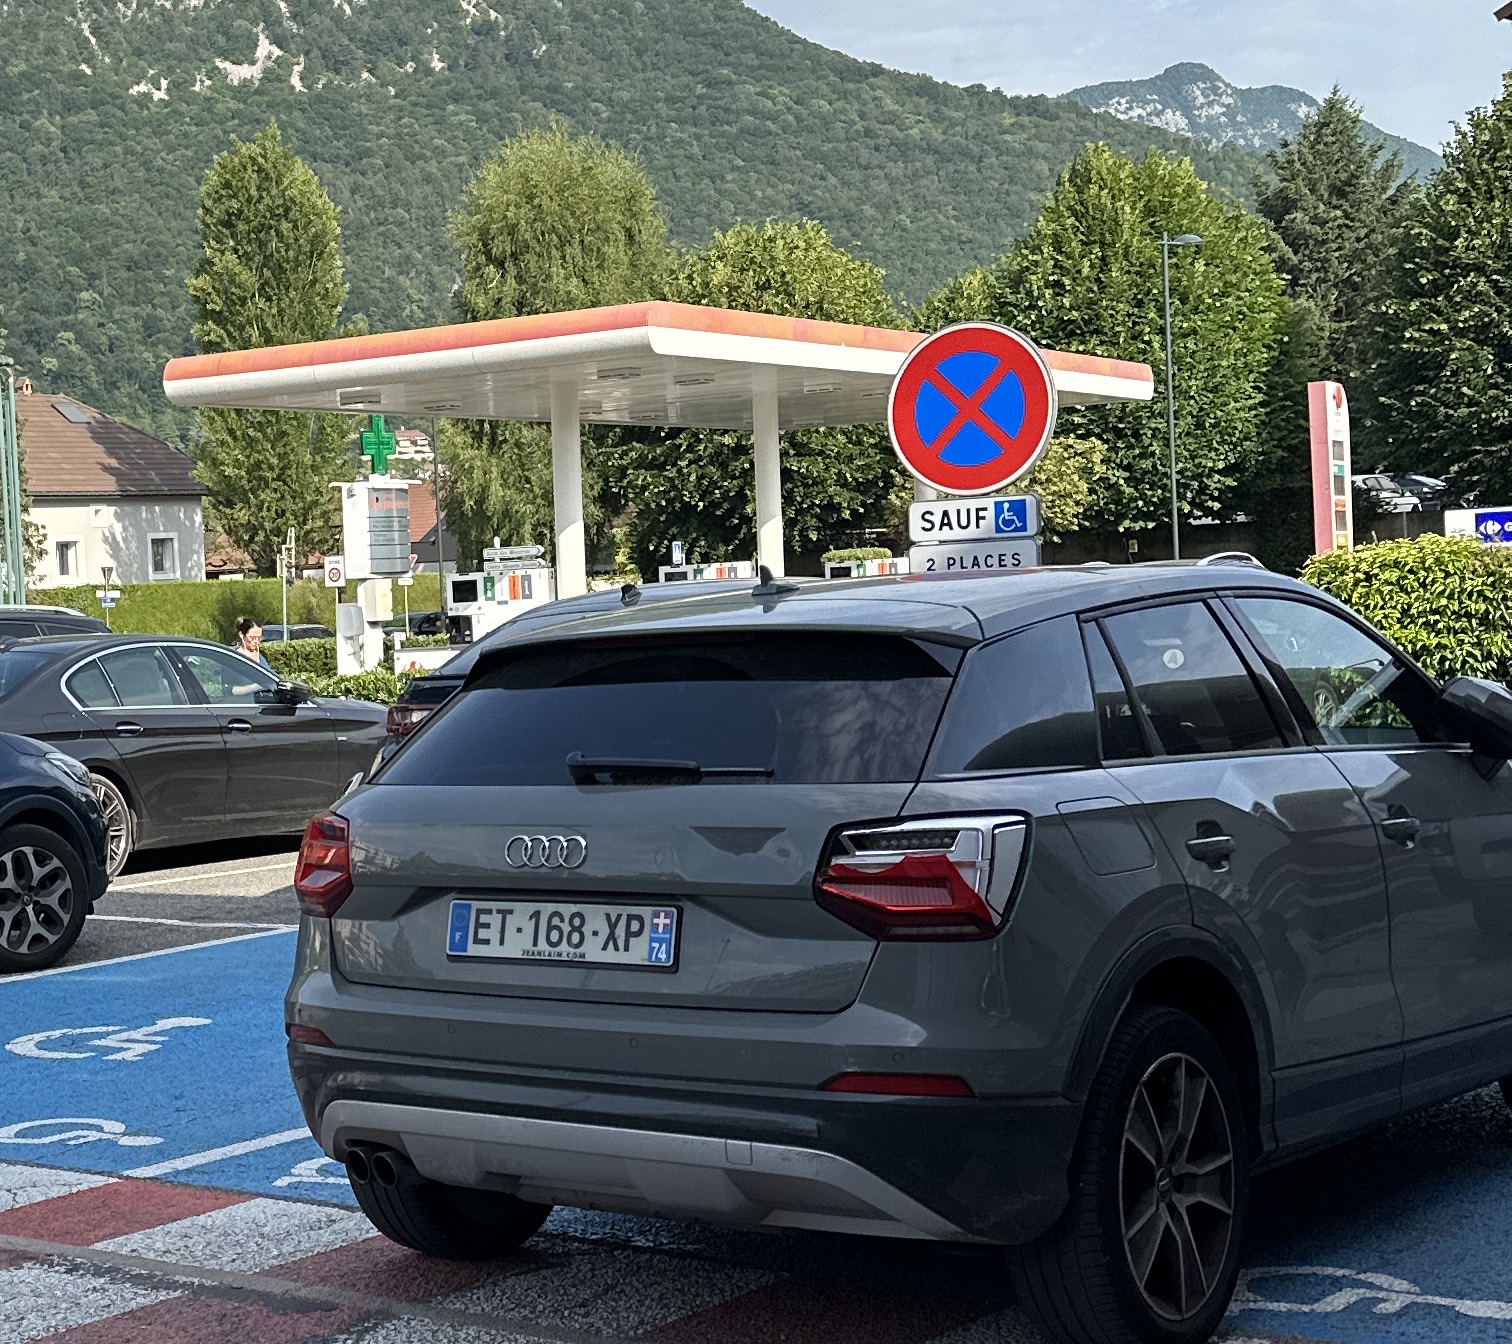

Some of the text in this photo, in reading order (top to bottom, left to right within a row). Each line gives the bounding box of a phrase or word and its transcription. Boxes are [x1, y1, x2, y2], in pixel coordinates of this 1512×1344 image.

[920, 507, 988, 532] SAUF
[926, 552, 1022, 572] 2 PLACES
[454, 931, 463, 943] F
[472, 907, 646, 953] ET-168-XP
[651, 942, 667, 962] 74
